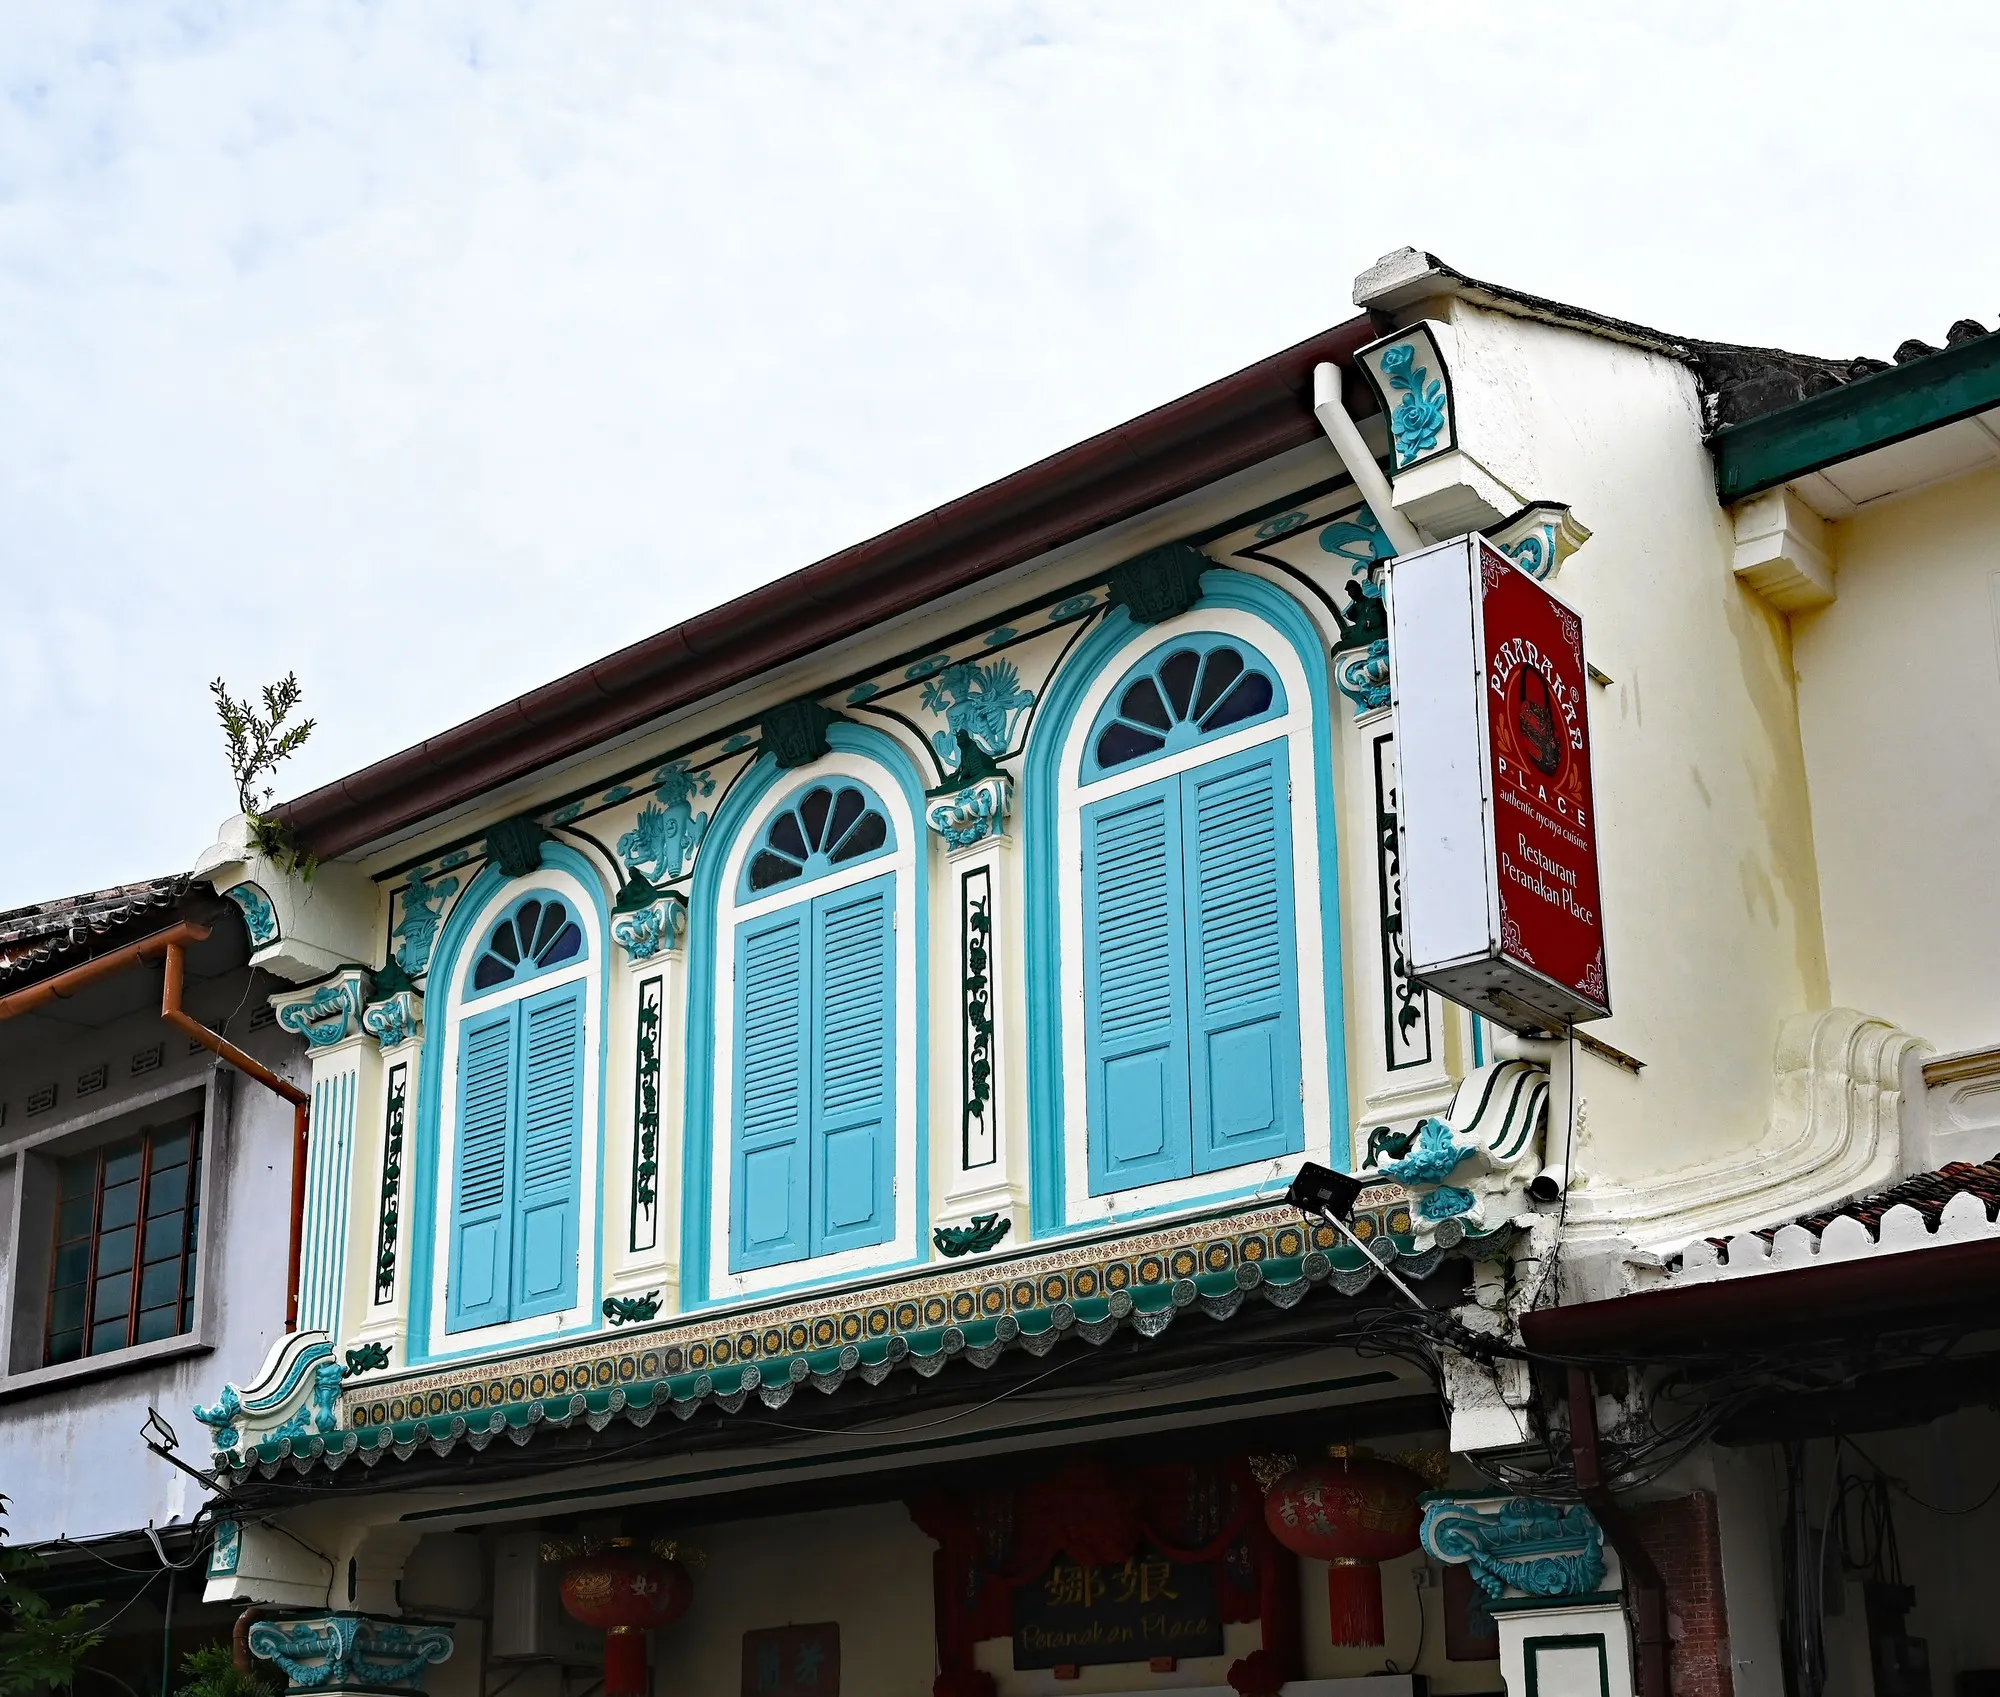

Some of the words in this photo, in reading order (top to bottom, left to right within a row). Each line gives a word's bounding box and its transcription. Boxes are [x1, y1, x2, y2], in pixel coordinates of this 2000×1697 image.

[1491, 637, 1583, 750] PERANAKAN
[1500, 789, 1536, 818] authentic
[1535, 811, 1562, 838] nyonya
[1562, 829, 1588, 851] cuisine
[1502, 851, 1560, 907] Peranakan
[1561, 887, 1594, 926] Place
[1518, 832, 1578, 889] Restaurant
[1020, 1620, 1134, 1650] Peranakan
[1140, 1612, 1209, 1640] Place
